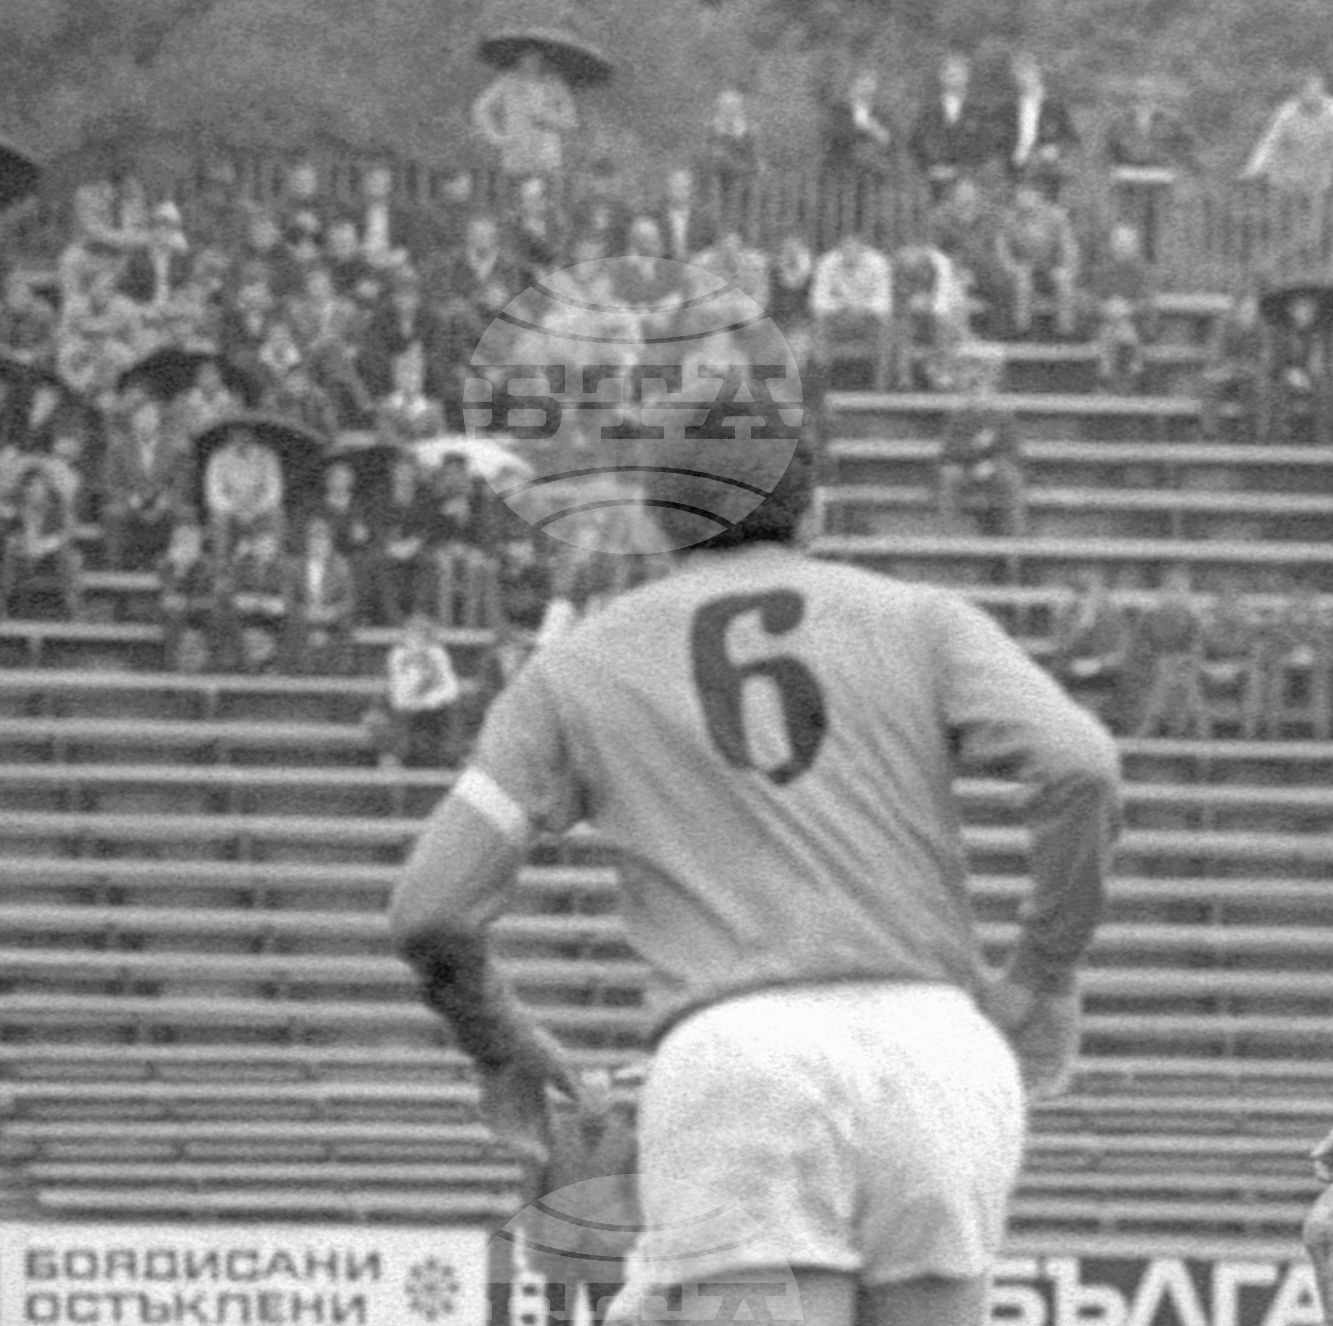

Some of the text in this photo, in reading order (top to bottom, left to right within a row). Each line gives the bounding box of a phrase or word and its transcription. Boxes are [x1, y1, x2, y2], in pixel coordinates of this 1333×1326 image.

[690, 588, 829, 786] 6
[24, 1248, 382, 1282] БОЯДИСАНИ
[24, 1290, 369, 1324] ОСТЪКЛЕНИ
